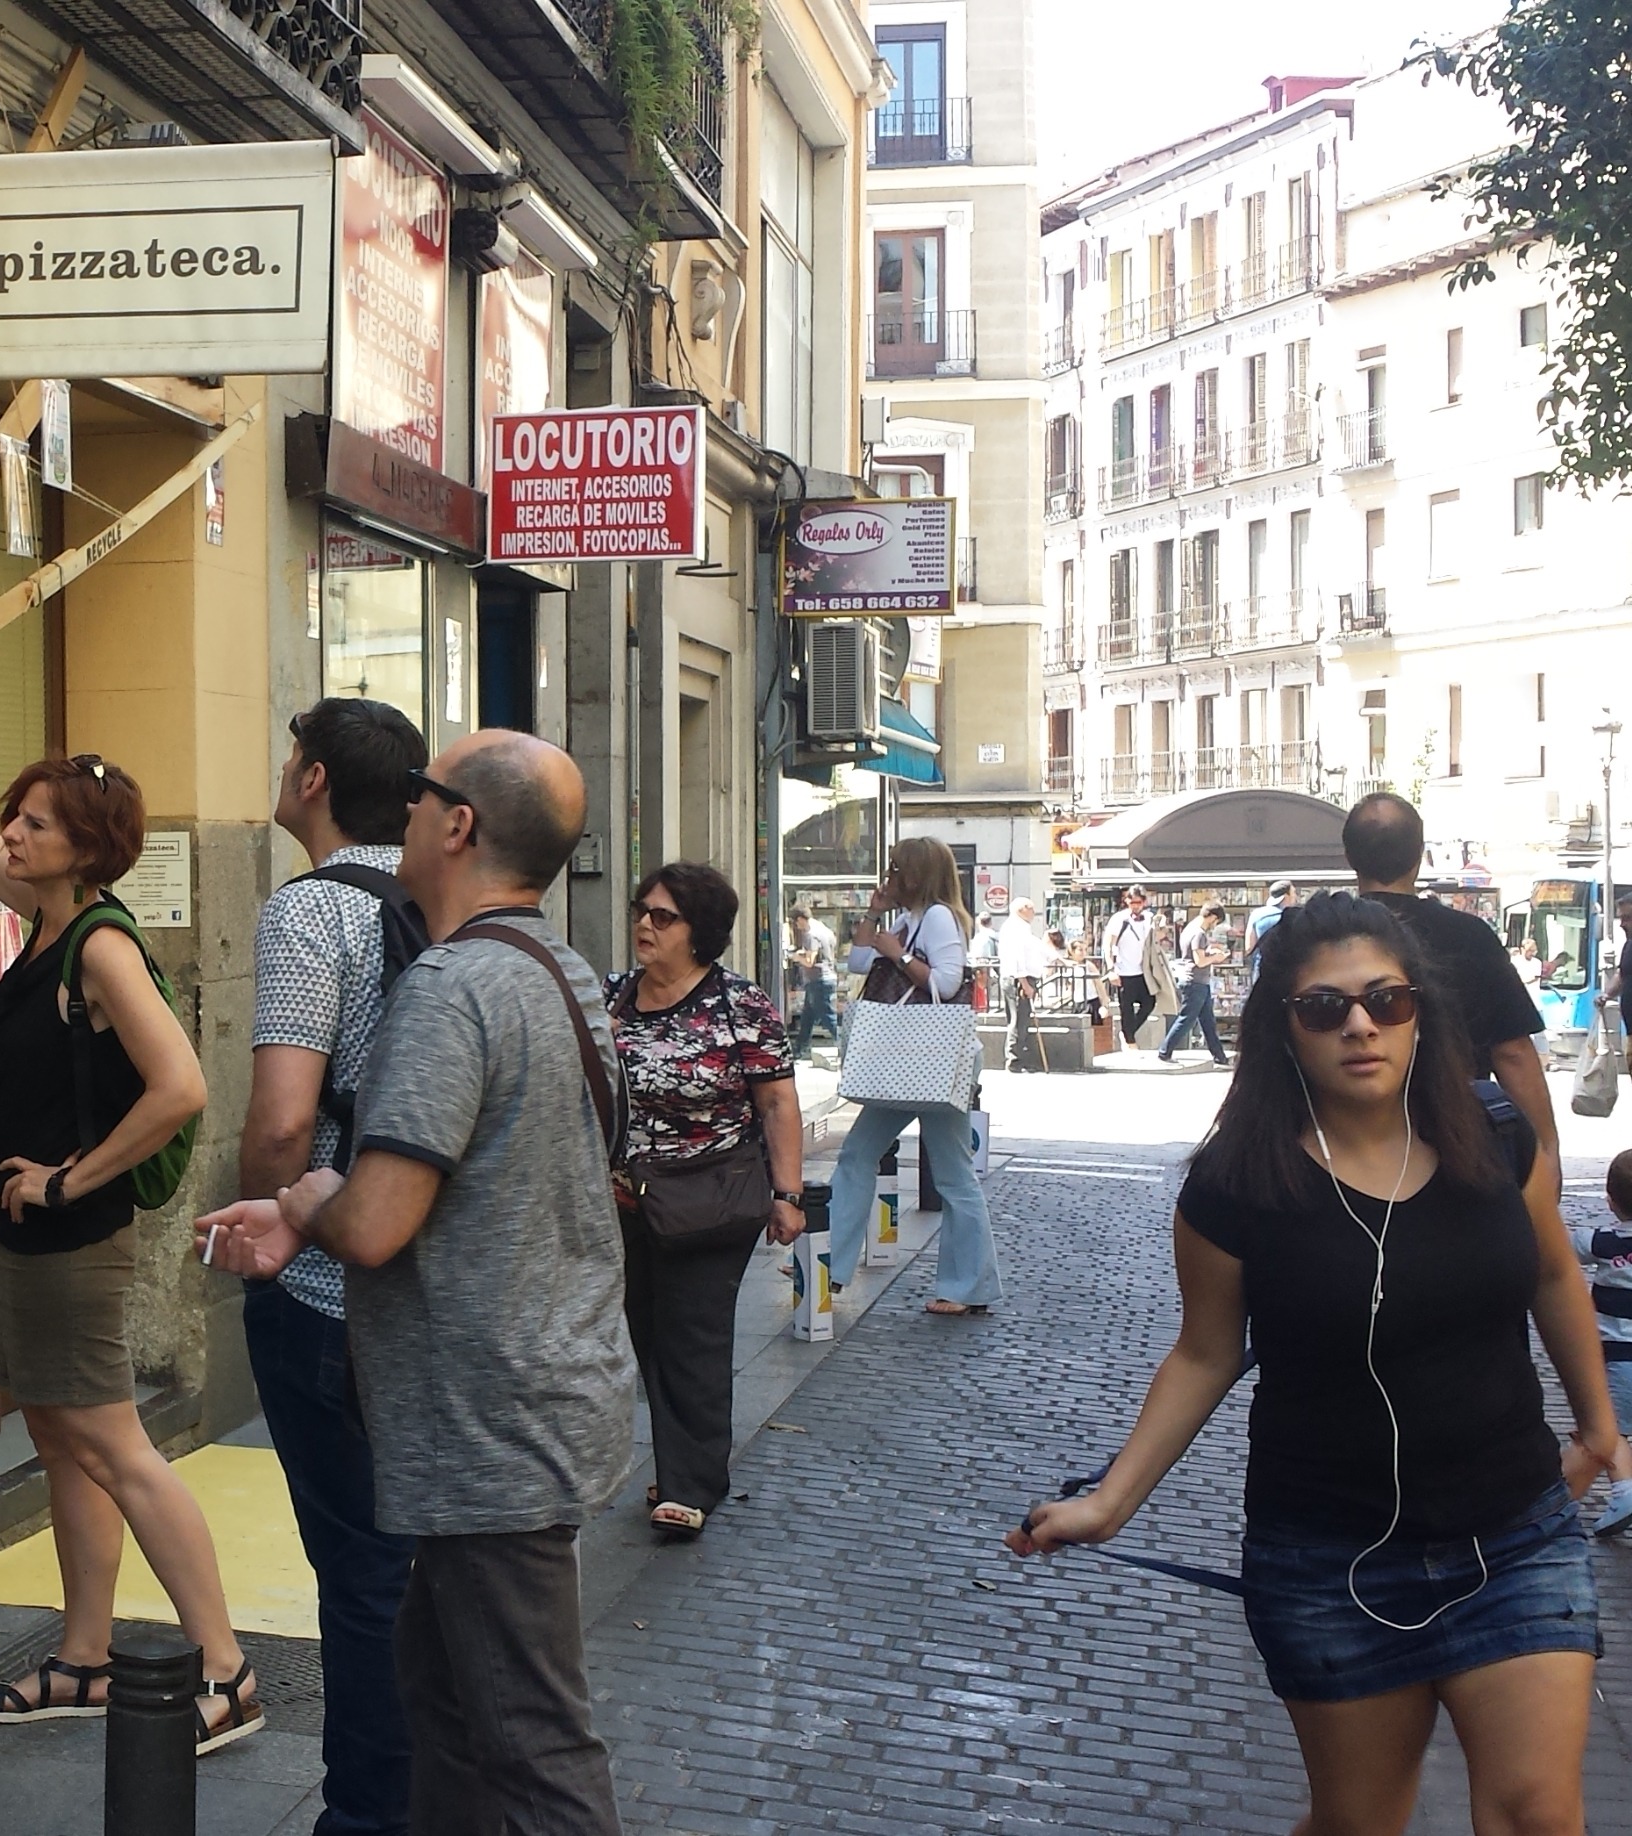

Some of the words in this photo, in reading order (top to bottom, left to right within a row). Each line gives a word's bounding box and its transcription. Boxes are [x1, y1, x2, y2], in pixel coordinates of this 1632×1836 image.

[345, 265, 440, 351] ACCESORIOS
[357, 306, 427, 375] RECARGA
[371, 350, 436, 409] MOVILES
[351, 402, 432, 468] IMPRESION
[494, 414, 693, 472] LOCUTORIO
[511, 477, 581, 504] INTERNET,
[583, 474, 673, 500] ACCESORIOS
[516, 503, 580, 528] RECARGA
[583, 503, 603, 526] DE
[605, 501, 667, 526] MOVILES
[802, 522, 851, 545] Regalos
[856, 521, 884, 544] Orly
[86, 523, 123, 567] RECYCLE
[501, 531, 580, 558] IMPRESION,
[582, 528, 682, 553] FOTOCOPIAS...
[795, 599, 826, 610] Tel:
[829, 598, 863, 610] 658
[867, 597, 902, 609] 664
[905, 595, 939, 608] 632
